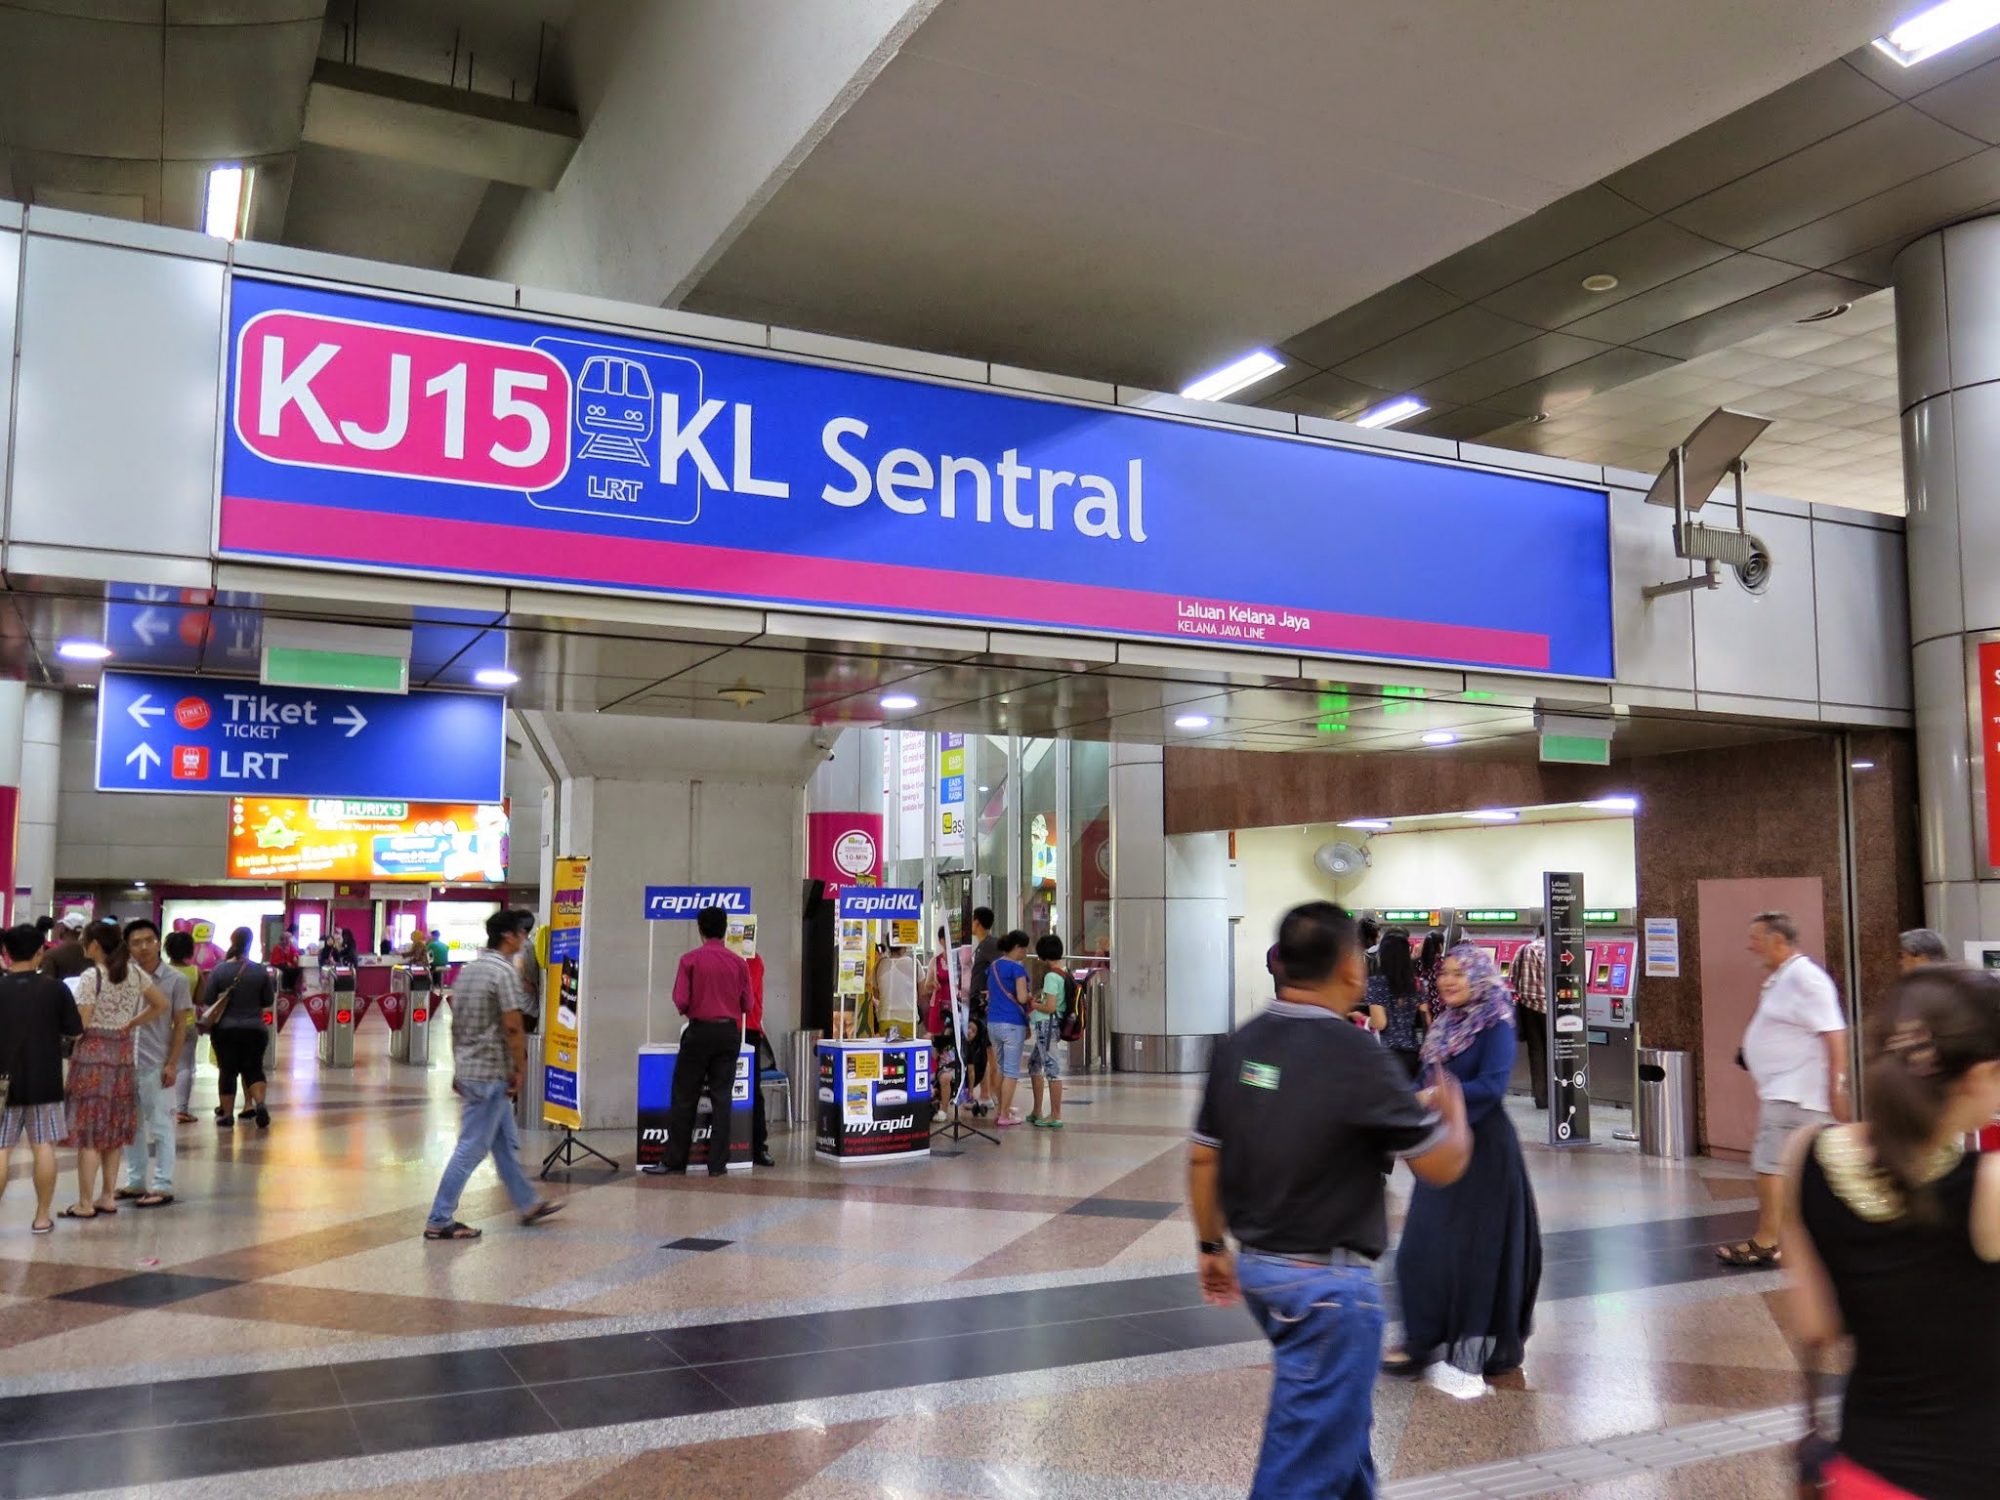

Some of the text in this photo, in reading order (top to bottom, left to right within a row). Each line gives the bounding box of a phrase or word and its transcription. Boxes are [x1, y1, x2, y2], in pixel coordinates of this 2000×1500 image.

[258, 336, 550, 468] KJ15
[659, 393, 1147, 543] KL Sentral
[588, 475, 643, 502] LRT
[1178, 600, 1310, 632] Laluan Kelana Jaya
[1178, 620, 1265, 639] KELANA JAYA LINE
[181, 706, 205, 718] TIKET
[224, 694, 317, 725] Tiket
[222, 723, 281, 739] TICKET
[220, 750, 288, 780] LRT
[347, 803, 401, 816] HURIX'S
[651, 893, 745, 913] rapidKL
[845, 894, 917, 913] rapidKL
[845, 1114, 914, 1135] myrapid
